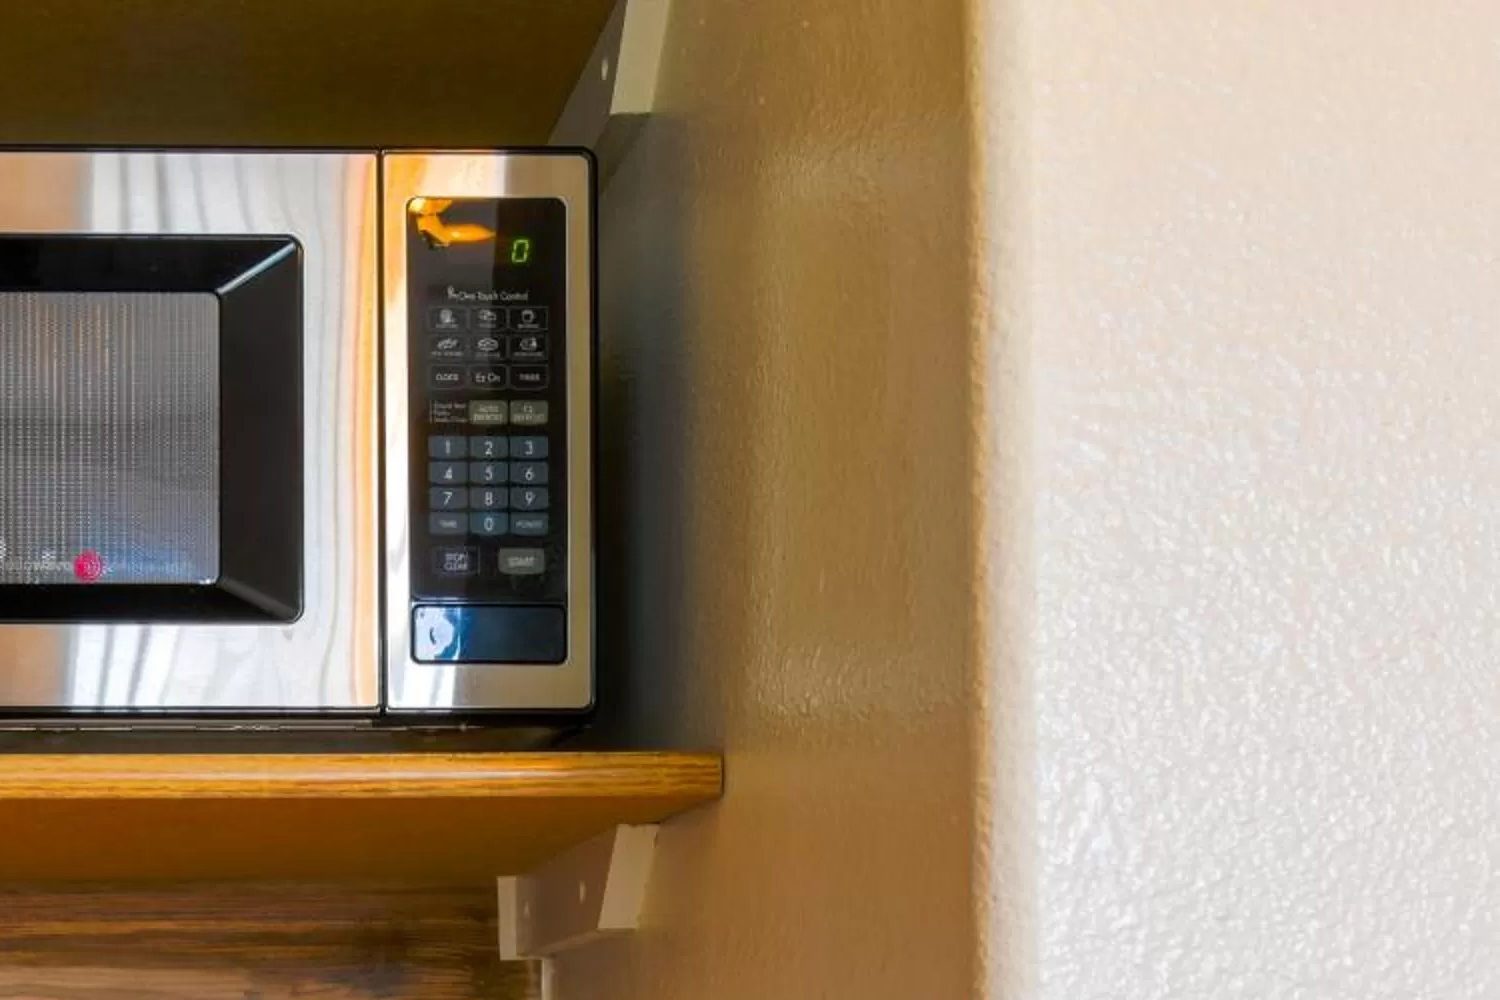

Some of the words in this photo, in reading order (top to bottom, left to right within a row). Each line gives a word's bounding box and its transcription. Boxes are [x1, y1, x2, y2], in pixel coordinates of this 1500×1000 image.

[511, 239, 530, 263] 0
[445, 440, 451, 454] 1
[484, 440, 493, 455] 2
[524, 440, 533, 455] 3
[443, 466, 453, 480] 4
[484, 466, 493, 481] 5
[524, 466, 534, 481] 6
[443, 491, 453, 506] 7
[484, 491, 493, 506] 8
[525, 491, 535, 506] 9
[484, 516, 494, 531] 0
